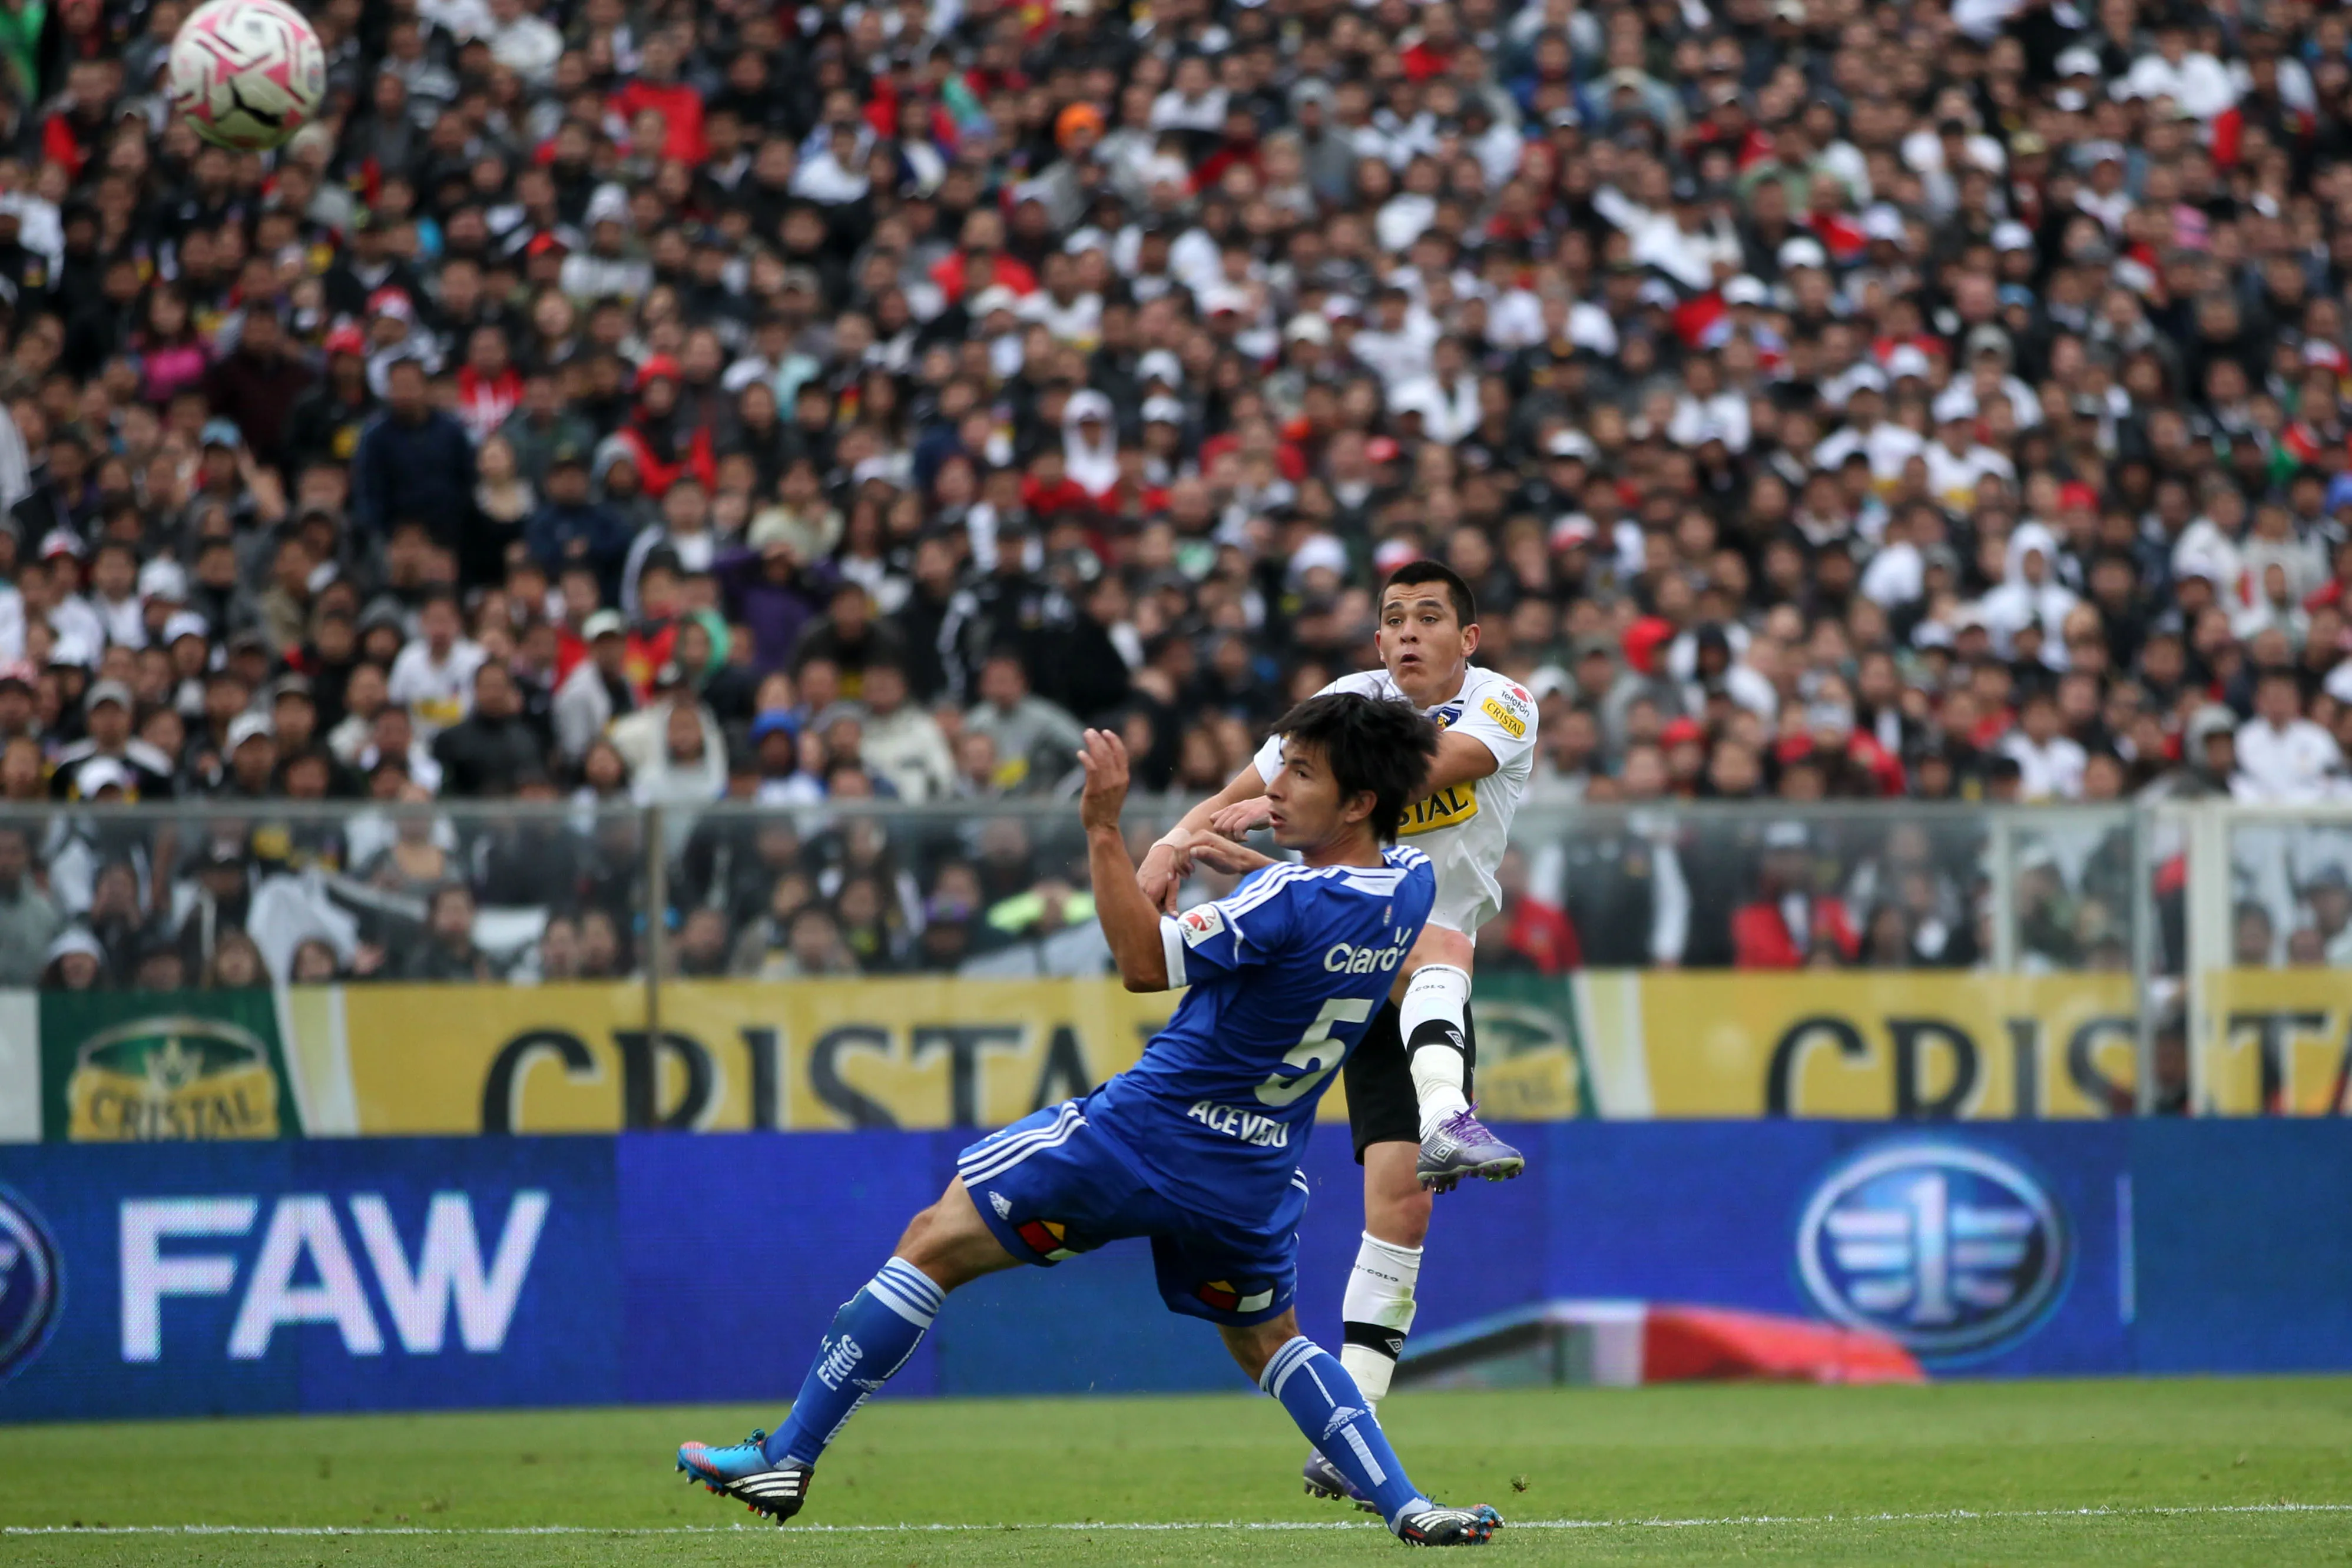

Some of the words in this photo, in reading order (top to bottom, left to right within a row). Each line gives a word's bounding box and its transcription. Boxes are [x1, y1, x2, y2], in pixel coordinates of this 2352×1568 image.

[1487, 703, 1521, 735] CRISTAL
[1324, 943, 1399, 974] Claro
[481, 1025, 1169, 1134] CRISTA
[1254, 999, 1374, 1107] 5
[1763, 1014, 2352, 1119] CRIST
[120, 1191, 551, 1363] FAW
